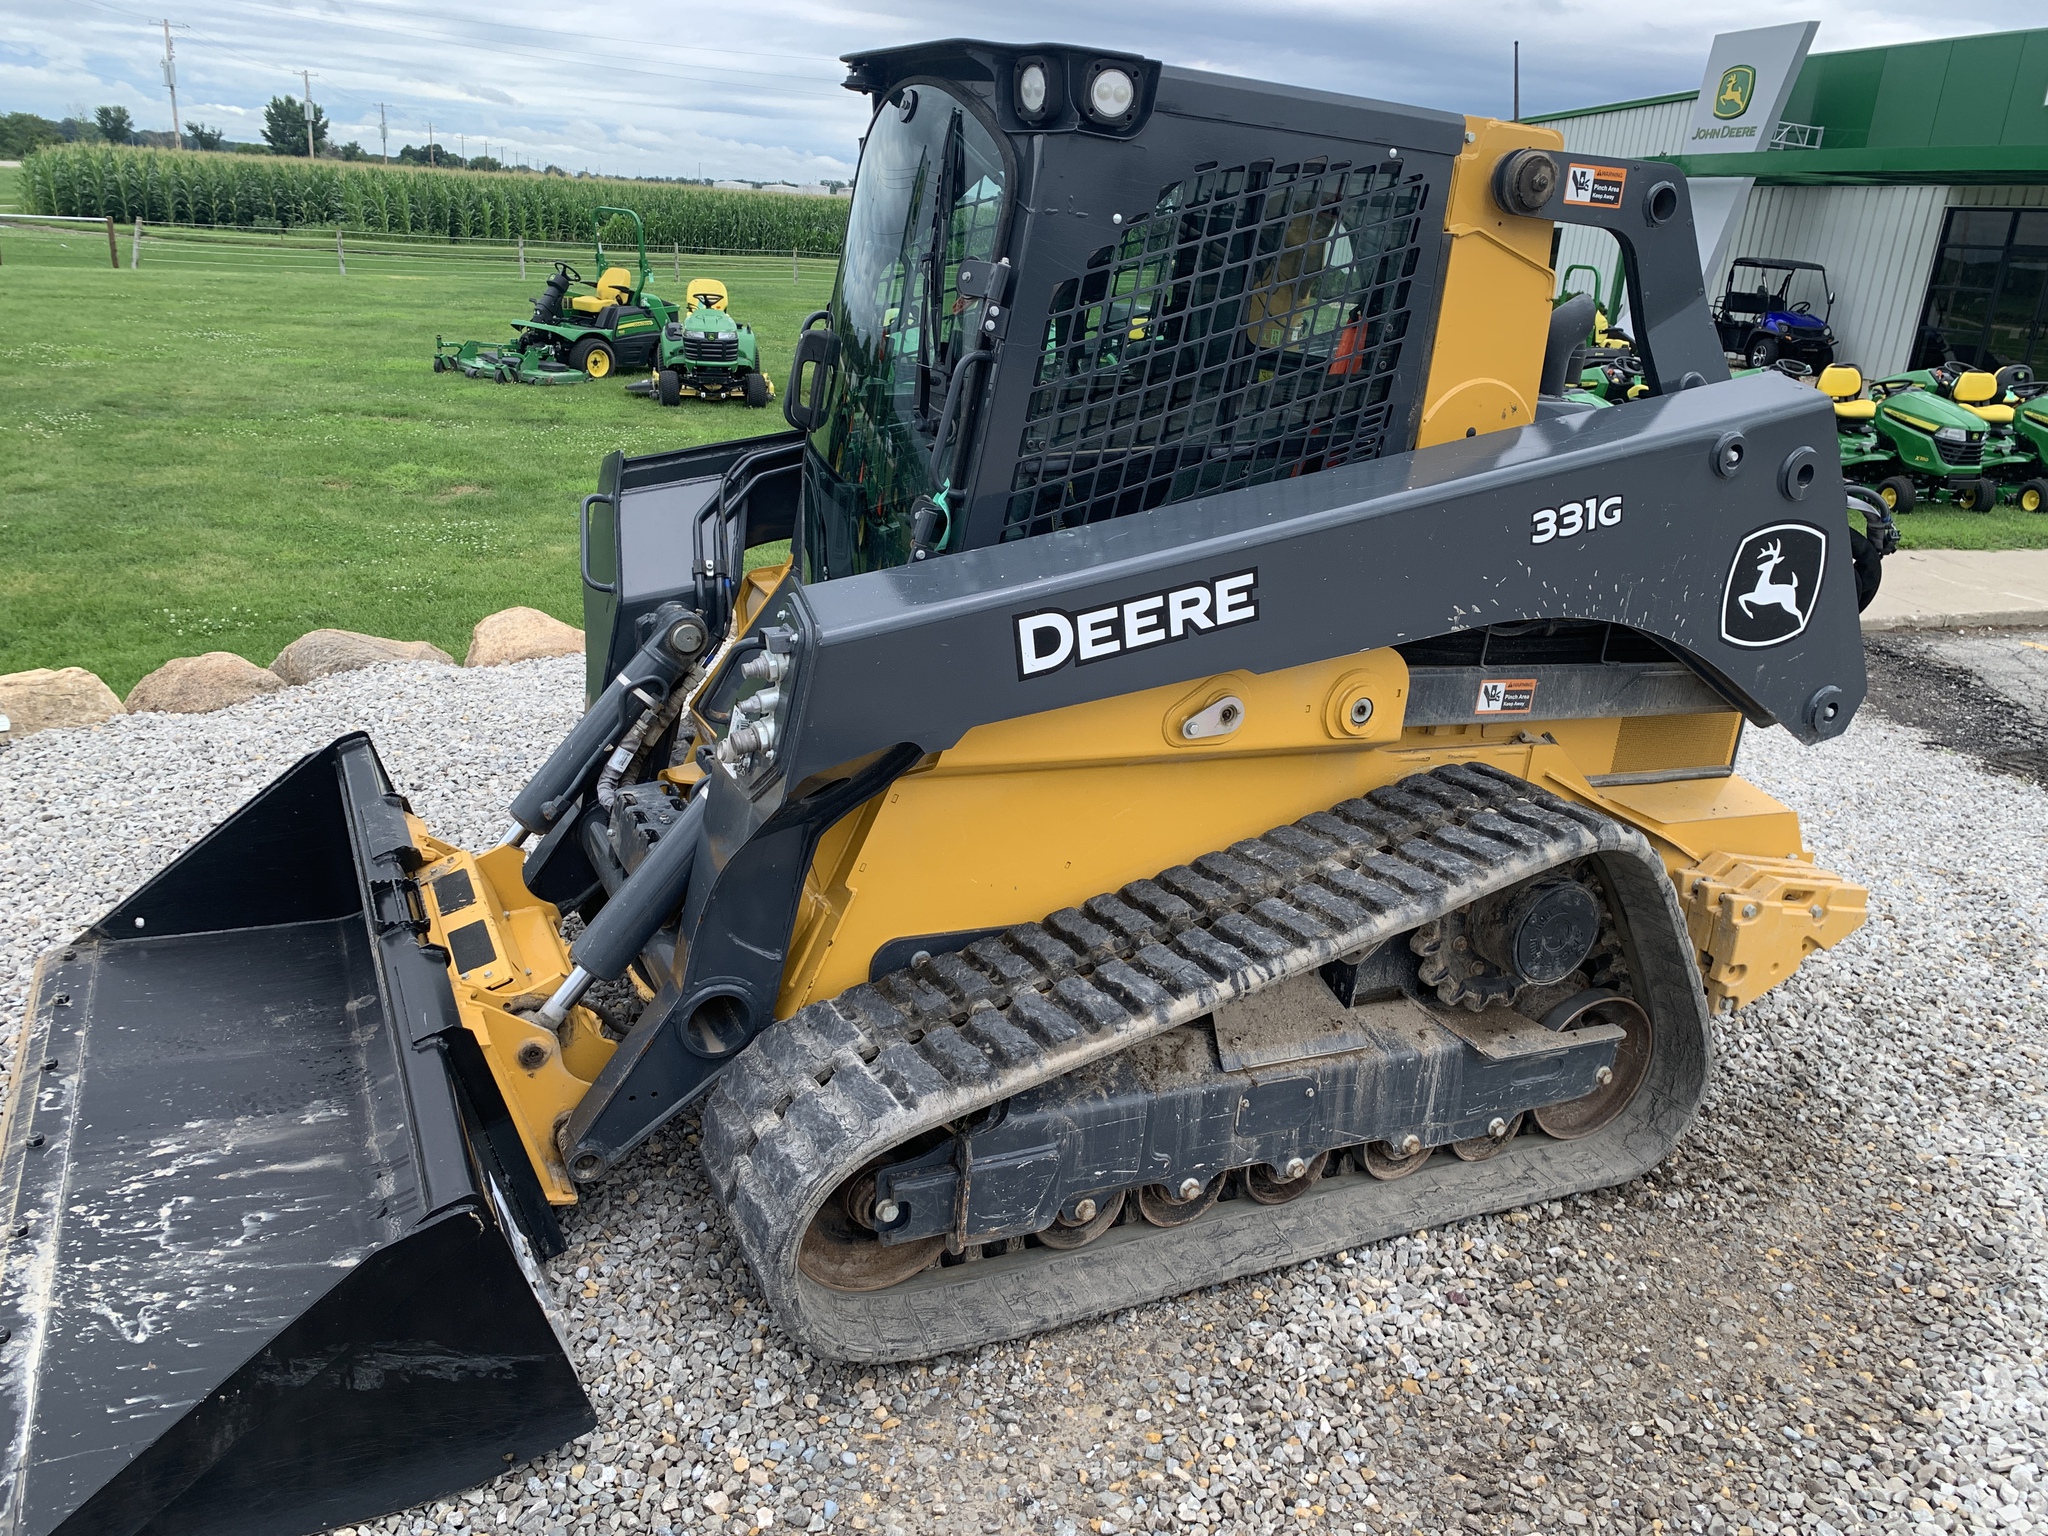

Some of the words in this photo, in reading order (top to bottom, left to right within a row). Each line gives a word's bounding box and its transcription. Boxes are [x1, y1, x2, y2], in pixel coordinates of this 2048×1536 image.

[1692, 127, 1721, 140] JOHN
[1721, 126, 1757, 138] DEERE
[1602, 170, 1623, 178] WARNING
[1593, 184, 1608, 192] Pinch
[1608, 185, 1620, 193] Area
[1592, 192, 1603, 200] Keep
[1603, 193, 1615, 201] Away
[1532, 496, 1622, 544] 331G
[1018, 572, 1256, 675] DEERE
